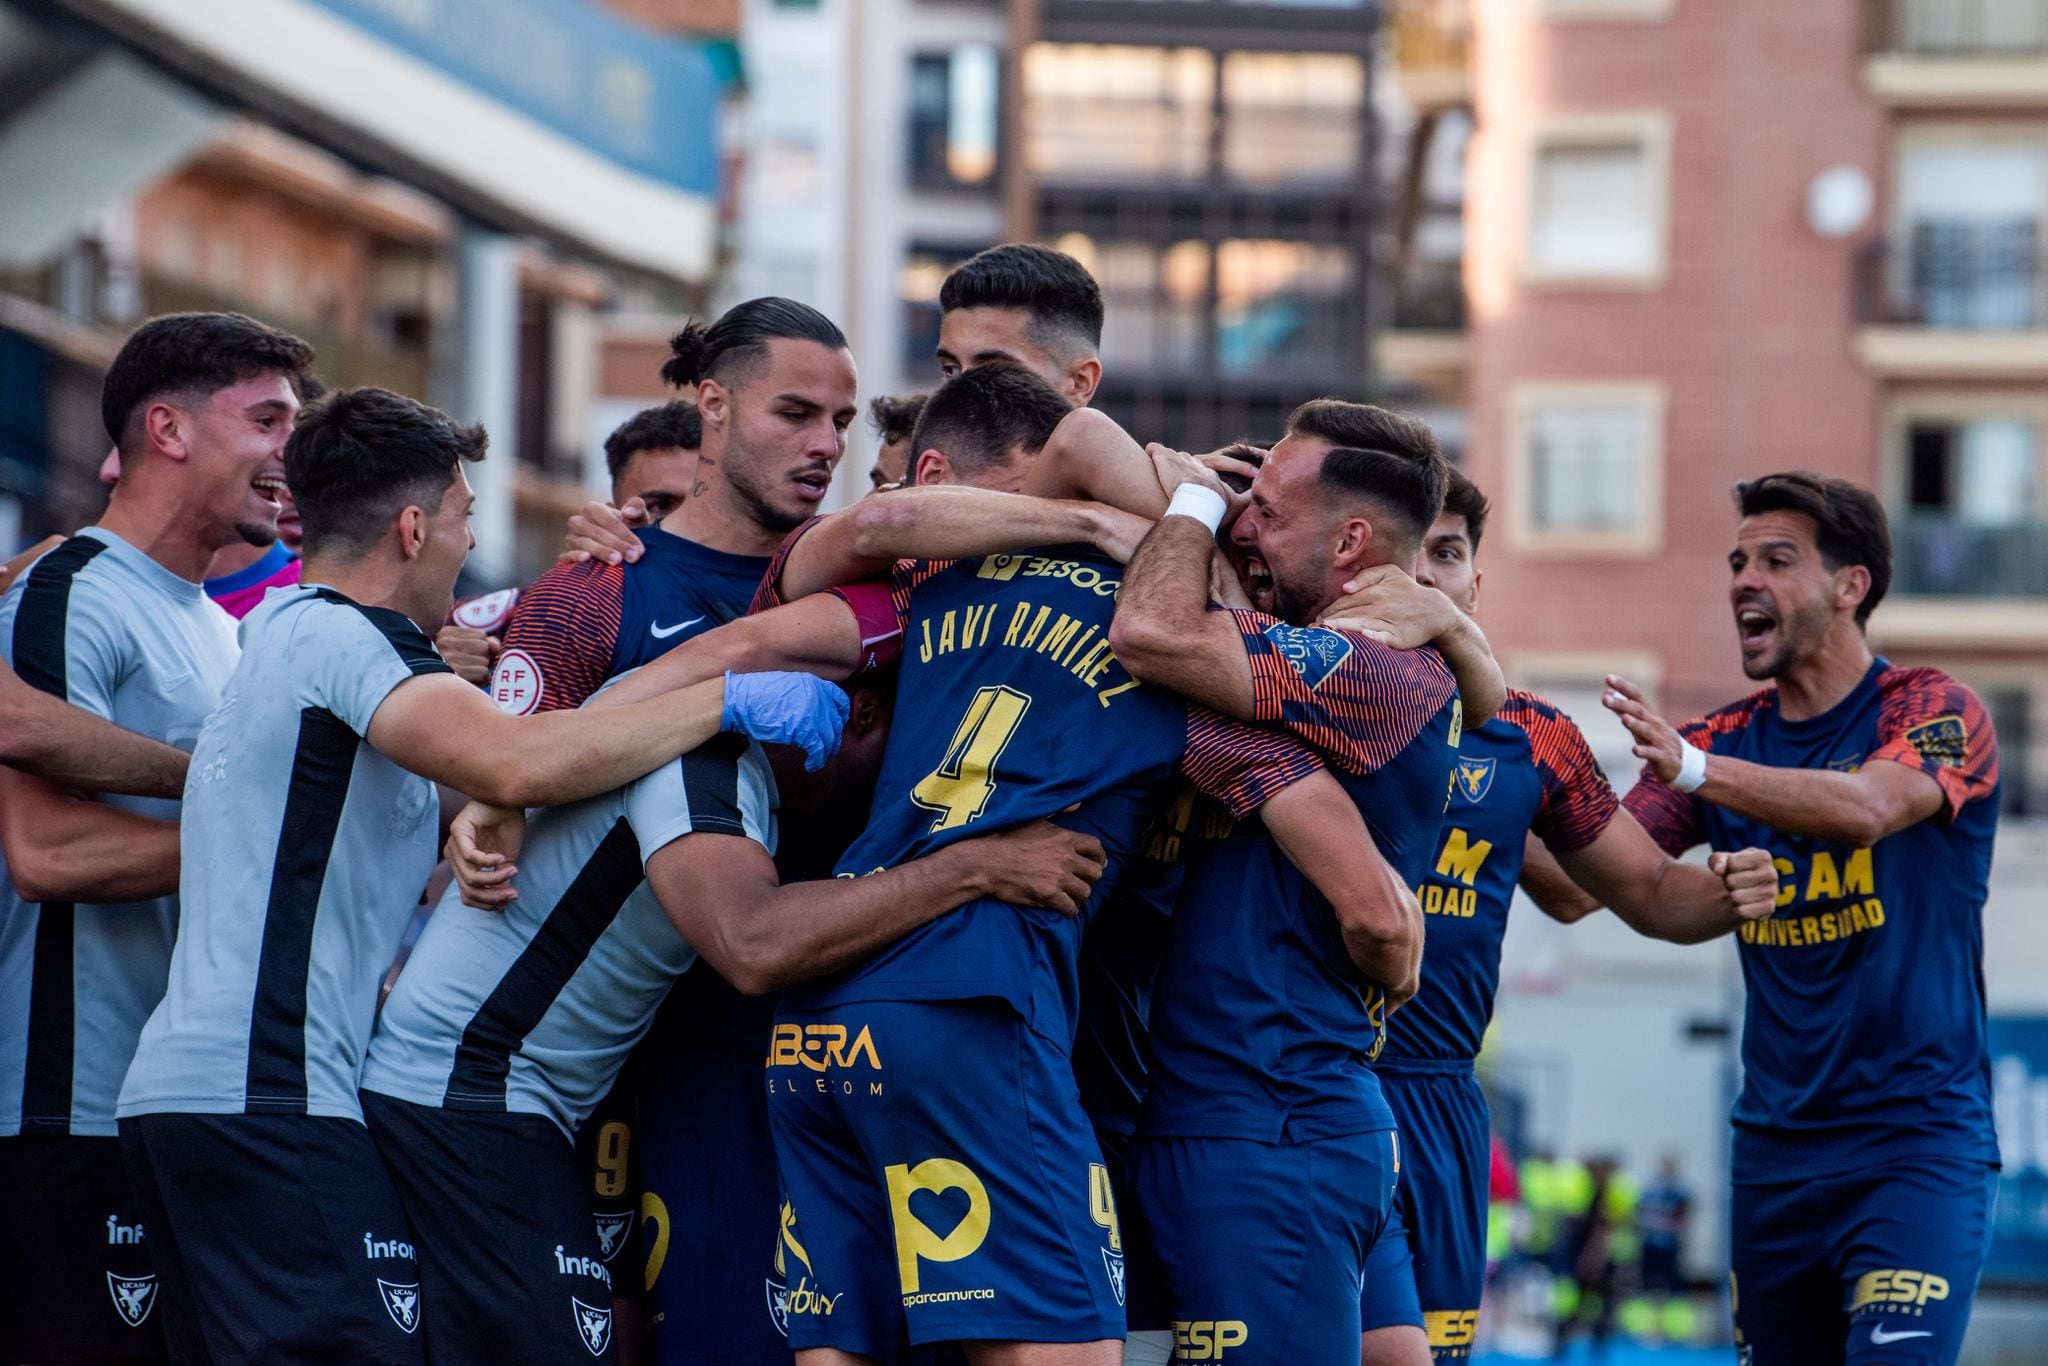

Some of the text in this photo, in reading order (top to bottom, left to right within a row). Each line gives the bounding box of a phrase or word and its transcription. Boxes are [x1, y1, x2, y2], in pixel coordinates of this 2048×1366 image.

[1022, 555, 1121, 601] BESOC
[919, 603, 998, 664] JAVI
[910, 684, 1032, 835] 4
[1773, 847, 1875, 908] CAM
[593, 1119, 632, 1199] 9
[122, 1281, 147, 1289] UCAM
[902, 1288, 995, 1308] aparcamurcia
[1852, 1268, 1950, 1306] ESP
[1172, 1320, 1248, 1360] ESP
[1423, 1308, 1479, 1347] ES
